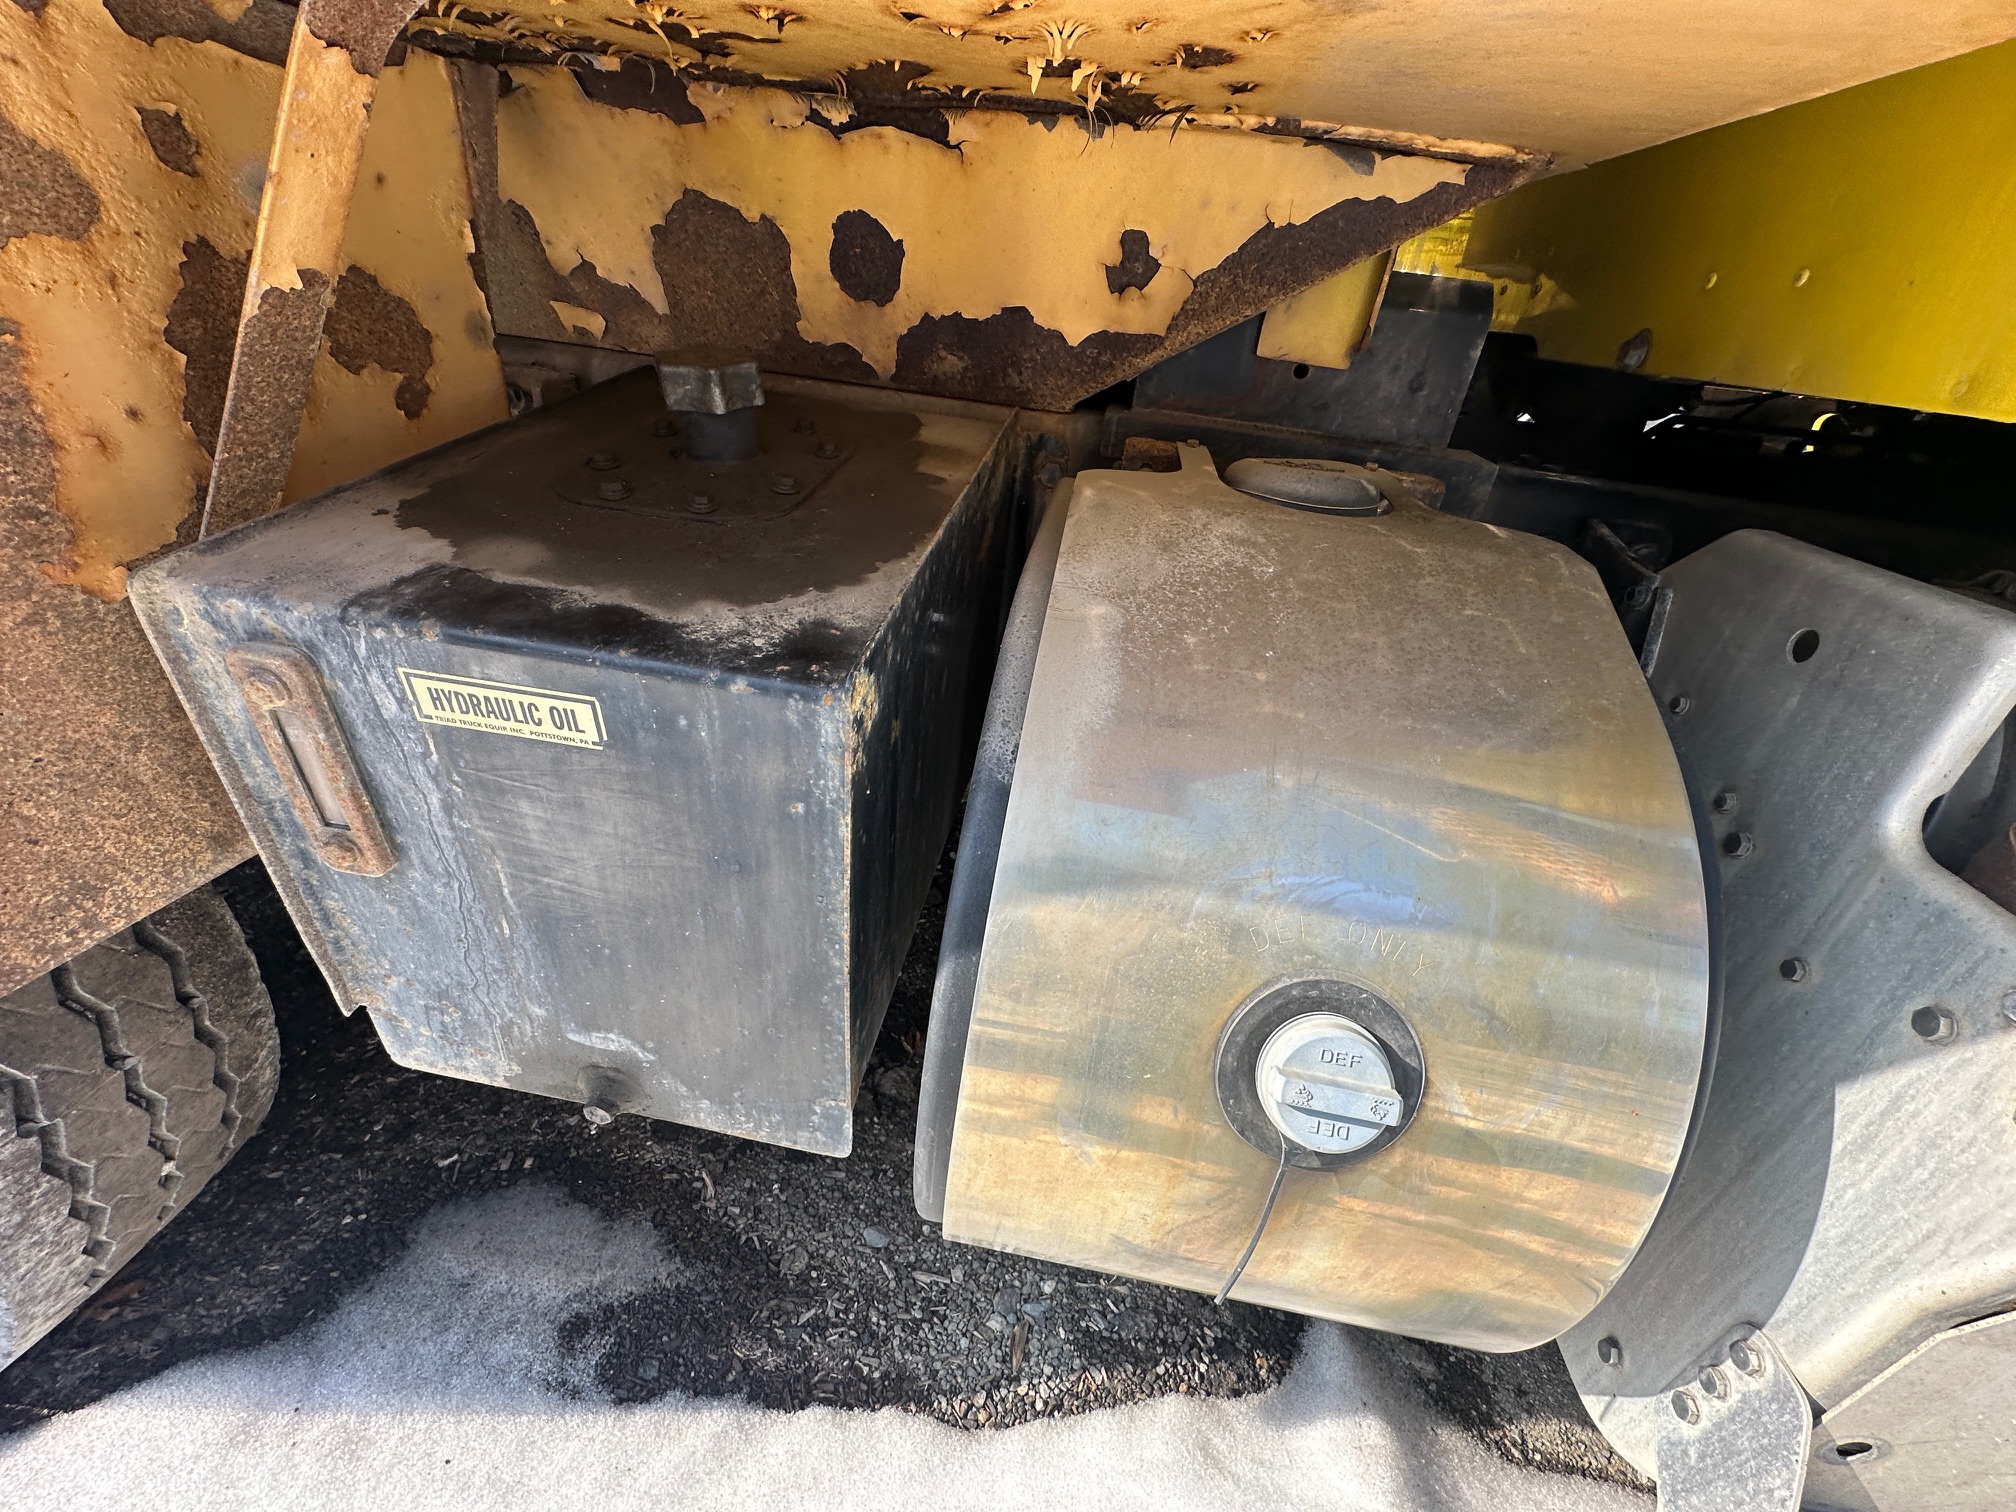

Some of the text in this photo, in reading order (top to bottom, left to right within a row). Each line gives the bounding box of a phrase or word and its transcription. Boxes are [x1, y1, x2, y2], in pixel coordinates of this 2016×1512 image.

[427, 687, 586, 734] HYDRAULIC OIL
[435, 715, 457, 724] TRIAD
[458, 719, 483, 729] TRUCK
[509, 727, 526, 735] INC.
[529, 730, 578, 744] POTTSTOWN,
[579, 738, 590, 746] PA
[1249, 914, 1313, 953] DEF
[1318, 1046, 1363, 1069] DEF
[1308, 1120, 1350, 1141] DEF
